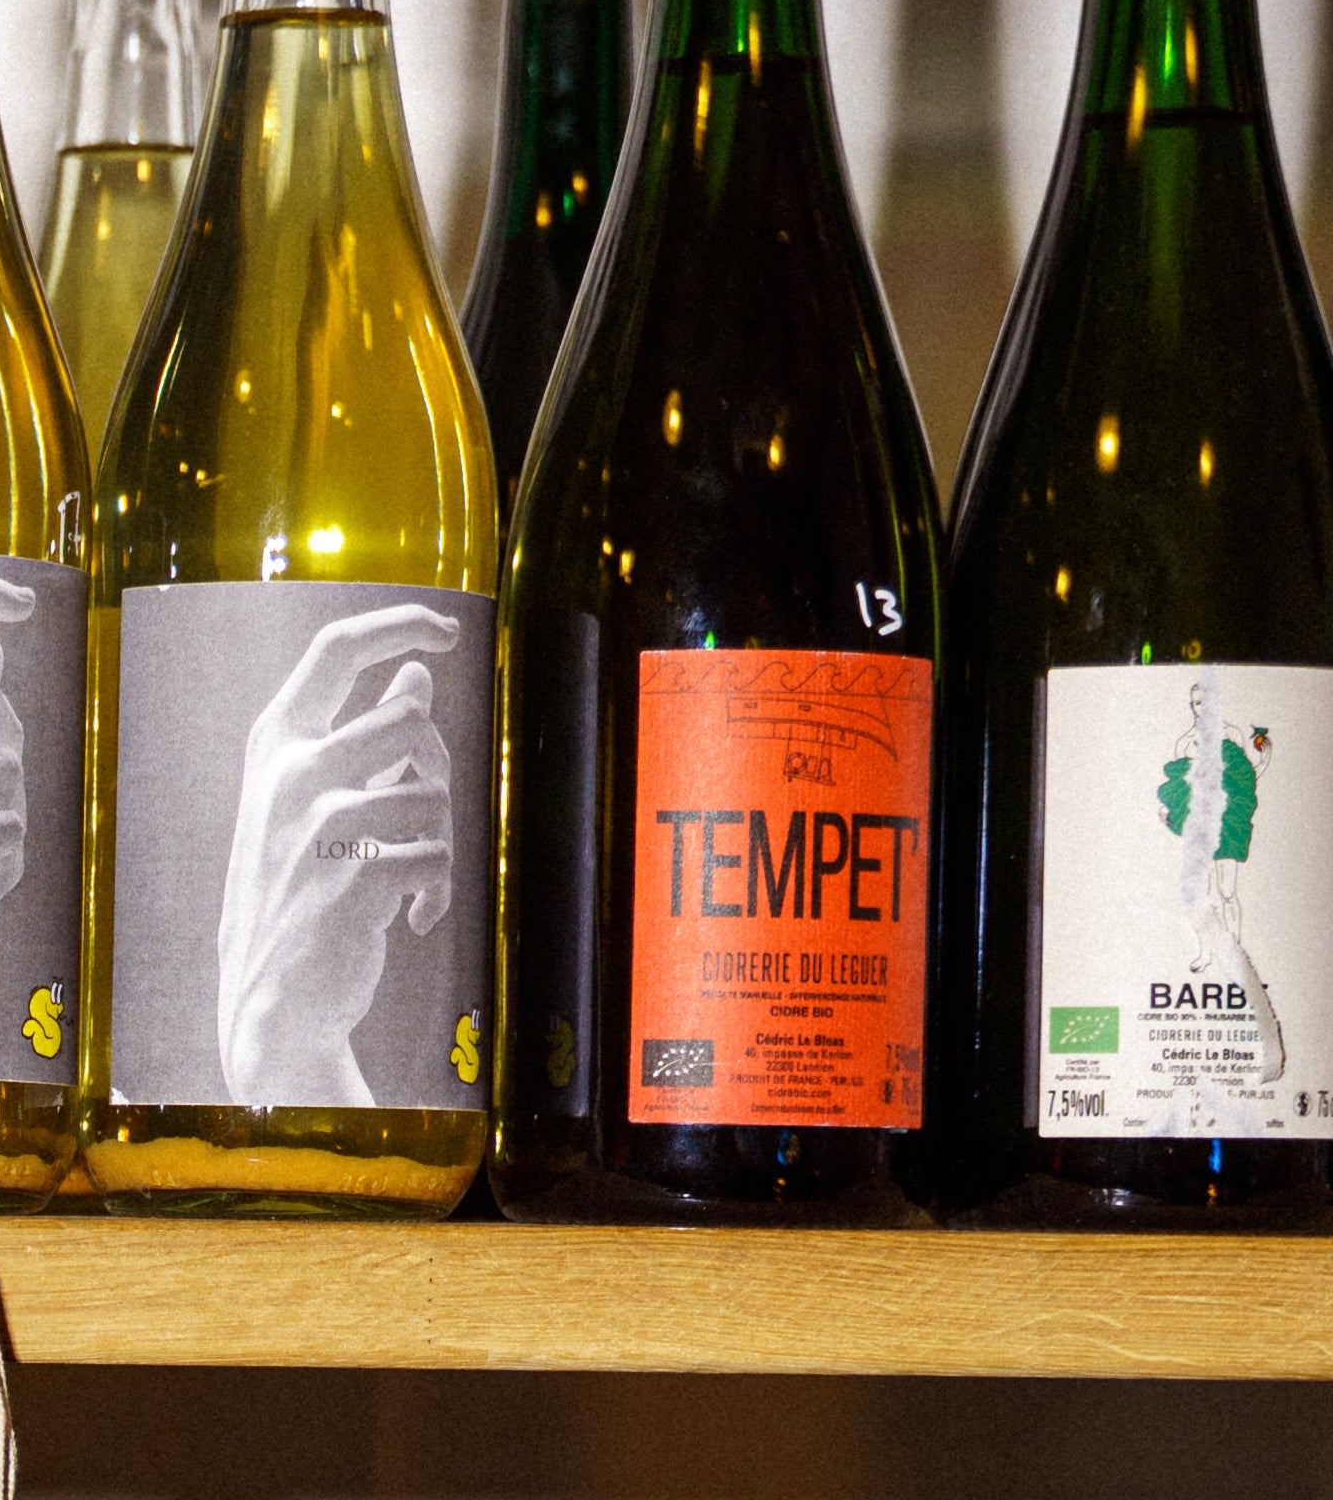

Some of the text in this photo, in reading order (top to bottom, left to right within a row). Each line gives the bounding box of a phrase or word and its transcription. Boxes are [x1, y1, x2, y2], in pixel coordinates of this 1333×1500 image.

[855, 582, 904, 636] 13
[315, 840, 380, 861] LORD
[702, 952, 889, 986] CIDRERIE DU LEGUER
[770, 1005, 834, 1019] CIDRE BIO
[756, 1032, 795, 1046] Cédric
[798, 1034, 811, 1046] Le
[1149, 1029, 1264, 1042] CIDRERIE DU LEGUE
[1162, 1048, 1255, 1061] Cédric Le Bloas
[1151, 1063, 1227, 1074] 40, impase de
[773, 1075, 786, 1085] DE
[788, 1075, 822, 1086] FRANCE
[1136, 1089, 1175, 1099] PRODUI
